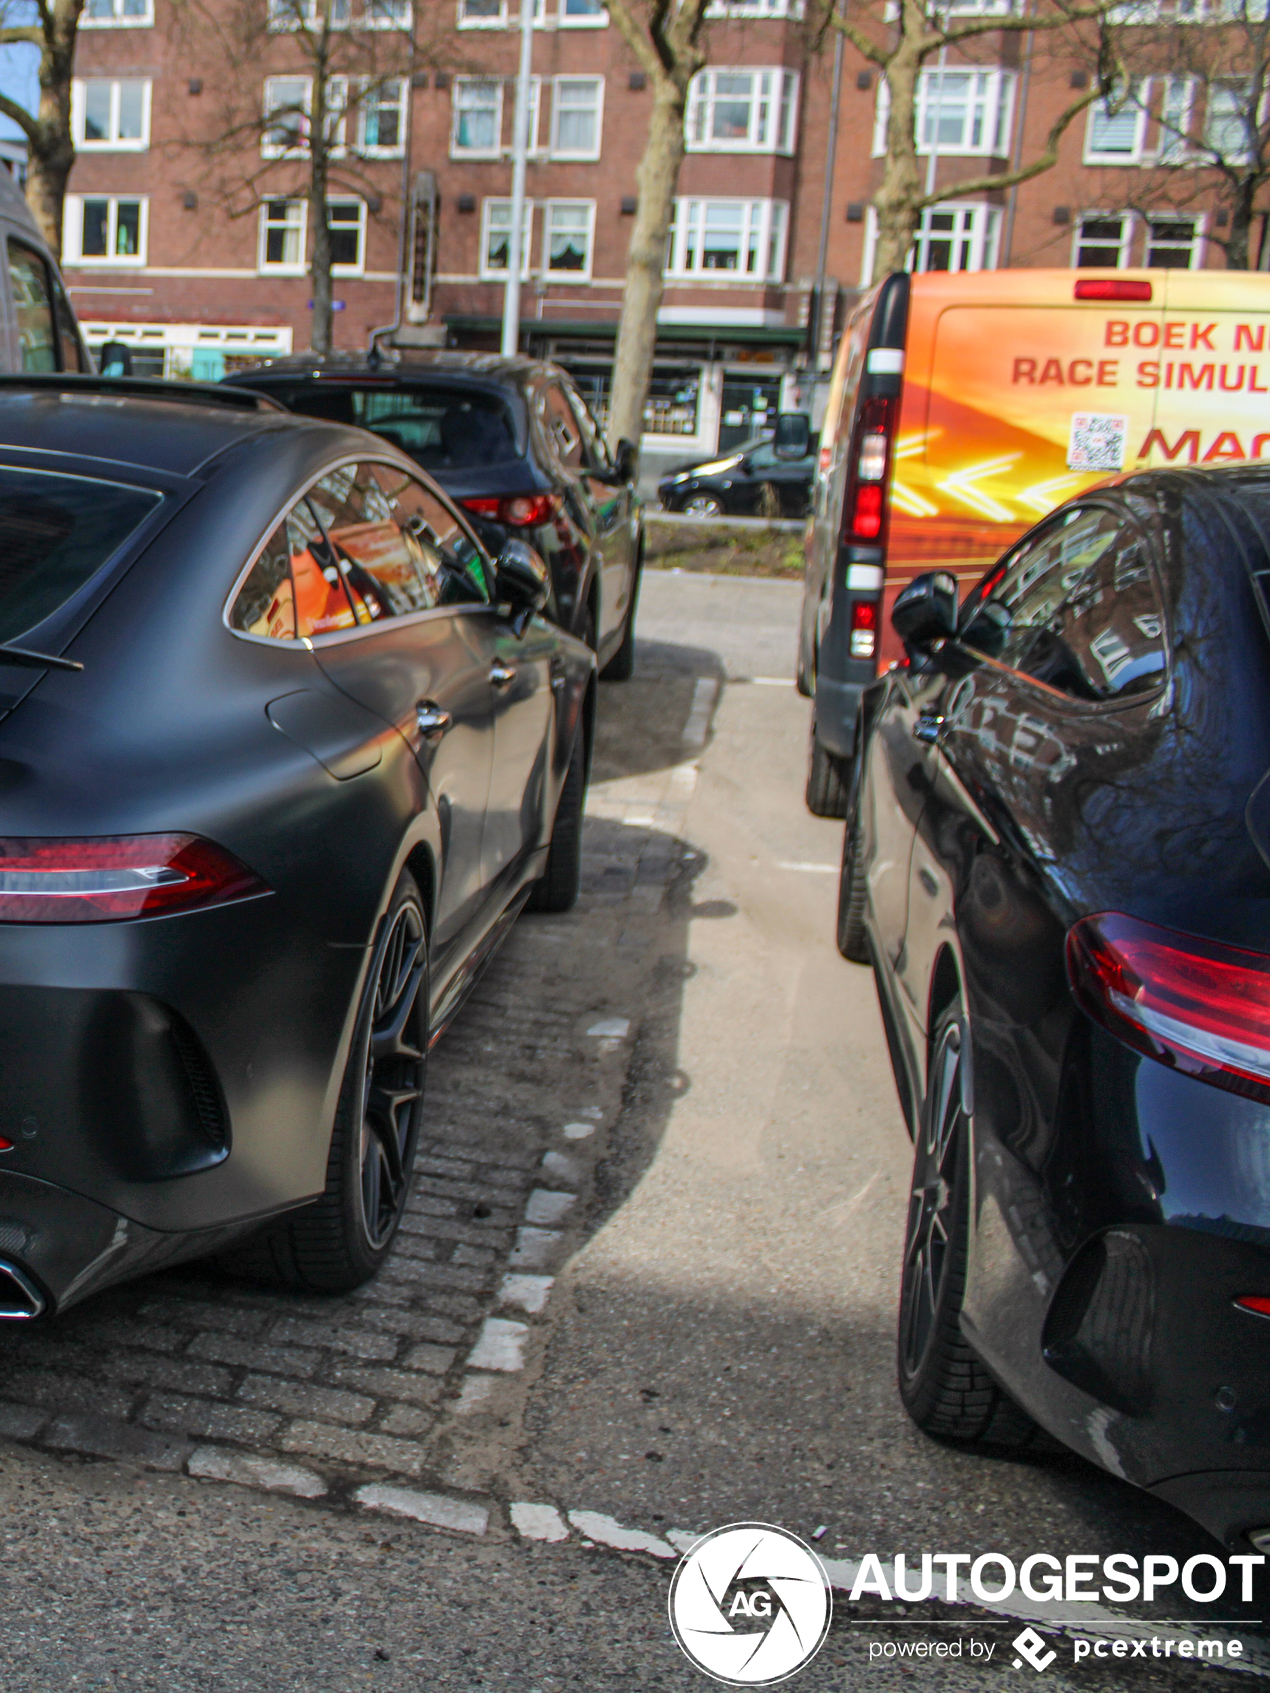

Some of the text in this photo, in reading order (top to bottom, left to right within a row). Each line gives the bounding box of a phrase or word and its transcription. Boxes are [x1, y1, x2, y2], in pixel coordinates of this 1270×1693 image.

[1104, 320, 1270, 353] BOEK N
[1011, 357, 1268, 393] RACE SIMUL
